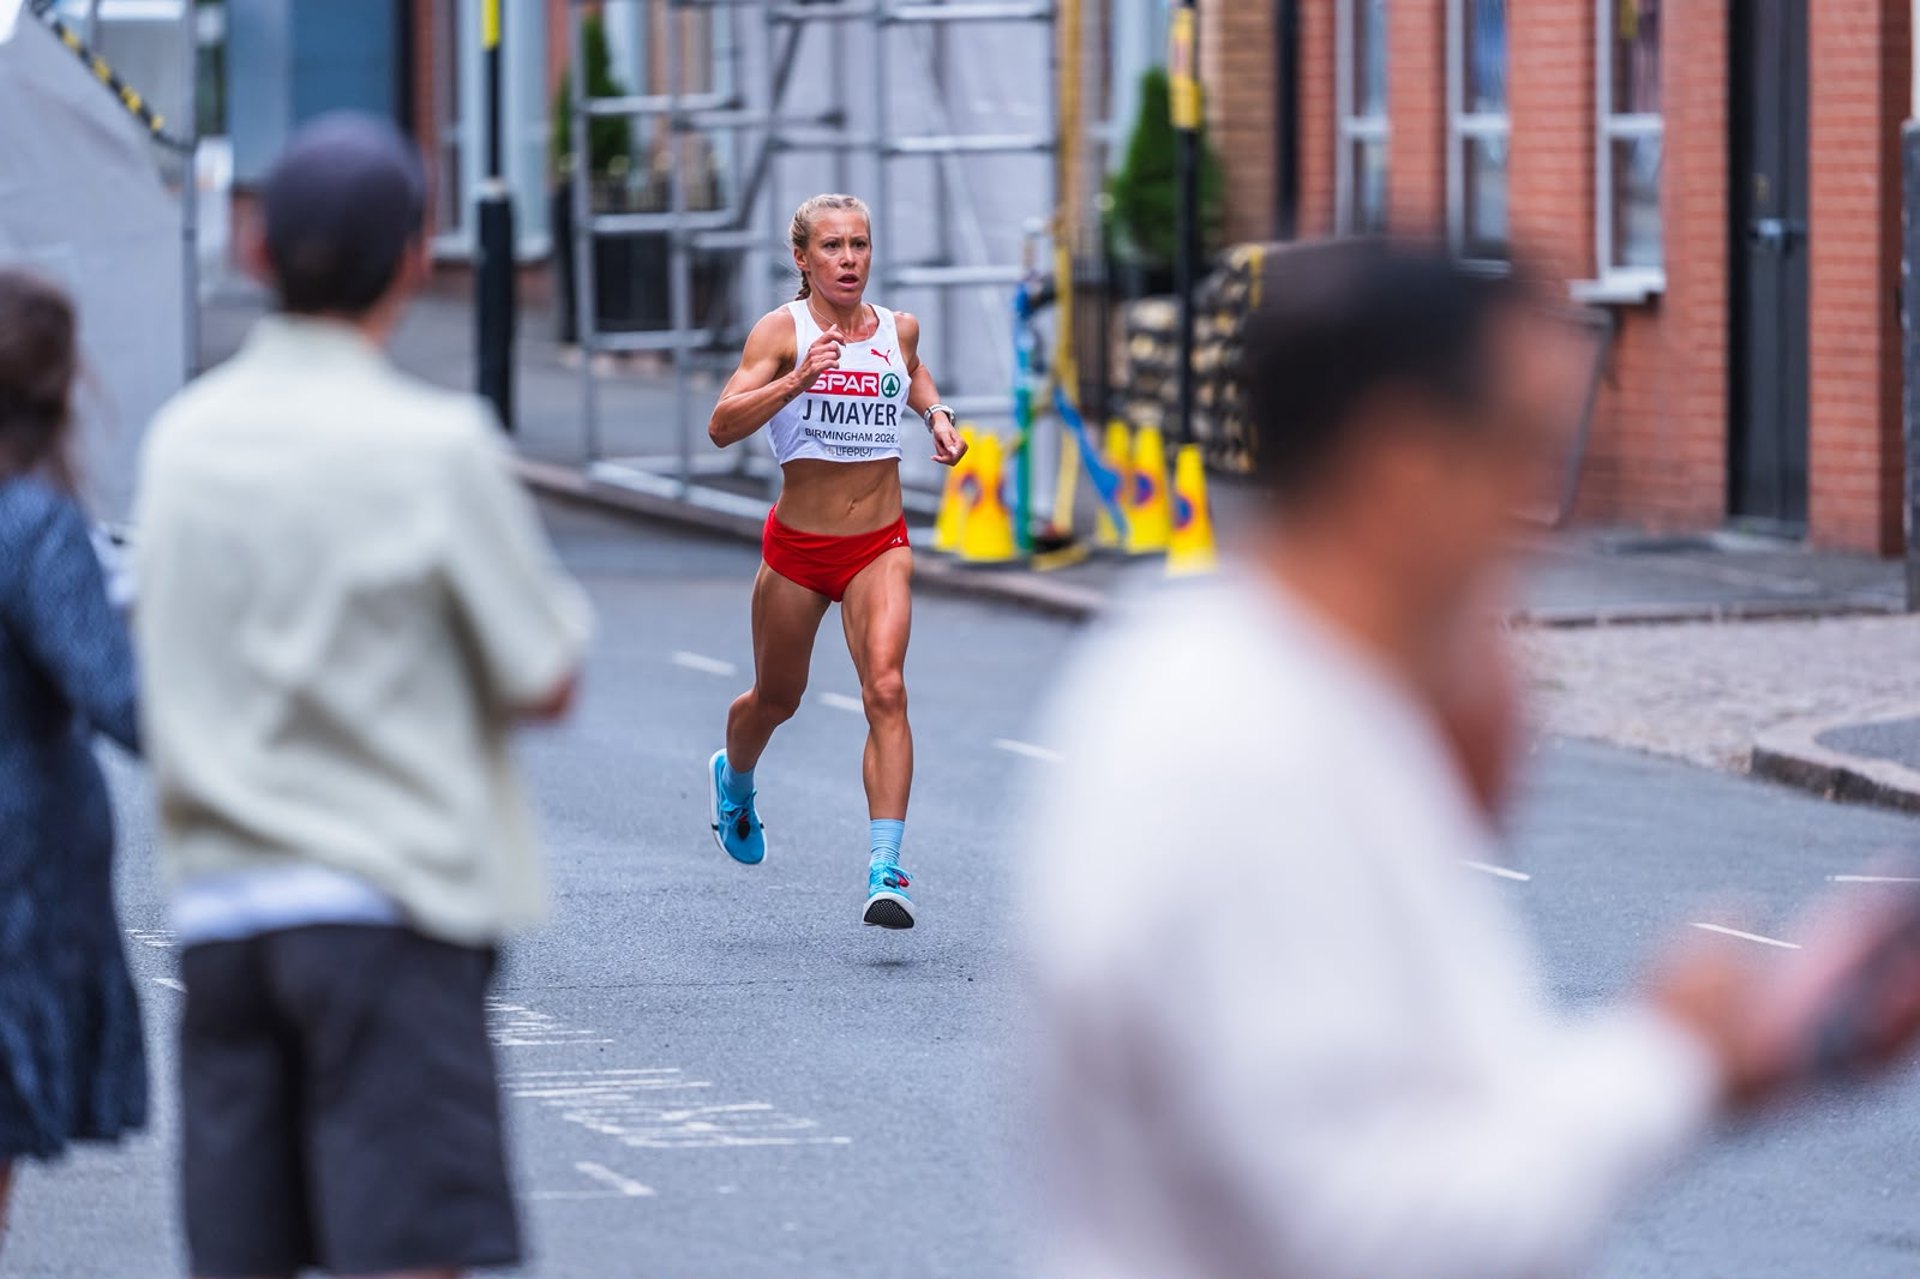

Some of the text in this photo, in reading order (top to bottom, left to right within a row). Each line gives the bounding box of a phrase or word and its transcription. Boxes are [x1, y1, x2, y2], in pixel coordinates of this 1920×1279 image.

[810, 373, 878, 394] SPAR
[802, 399, 897, 427] J MAYER
[804, 428, 895, 443] BIRMINGHAM 2026
